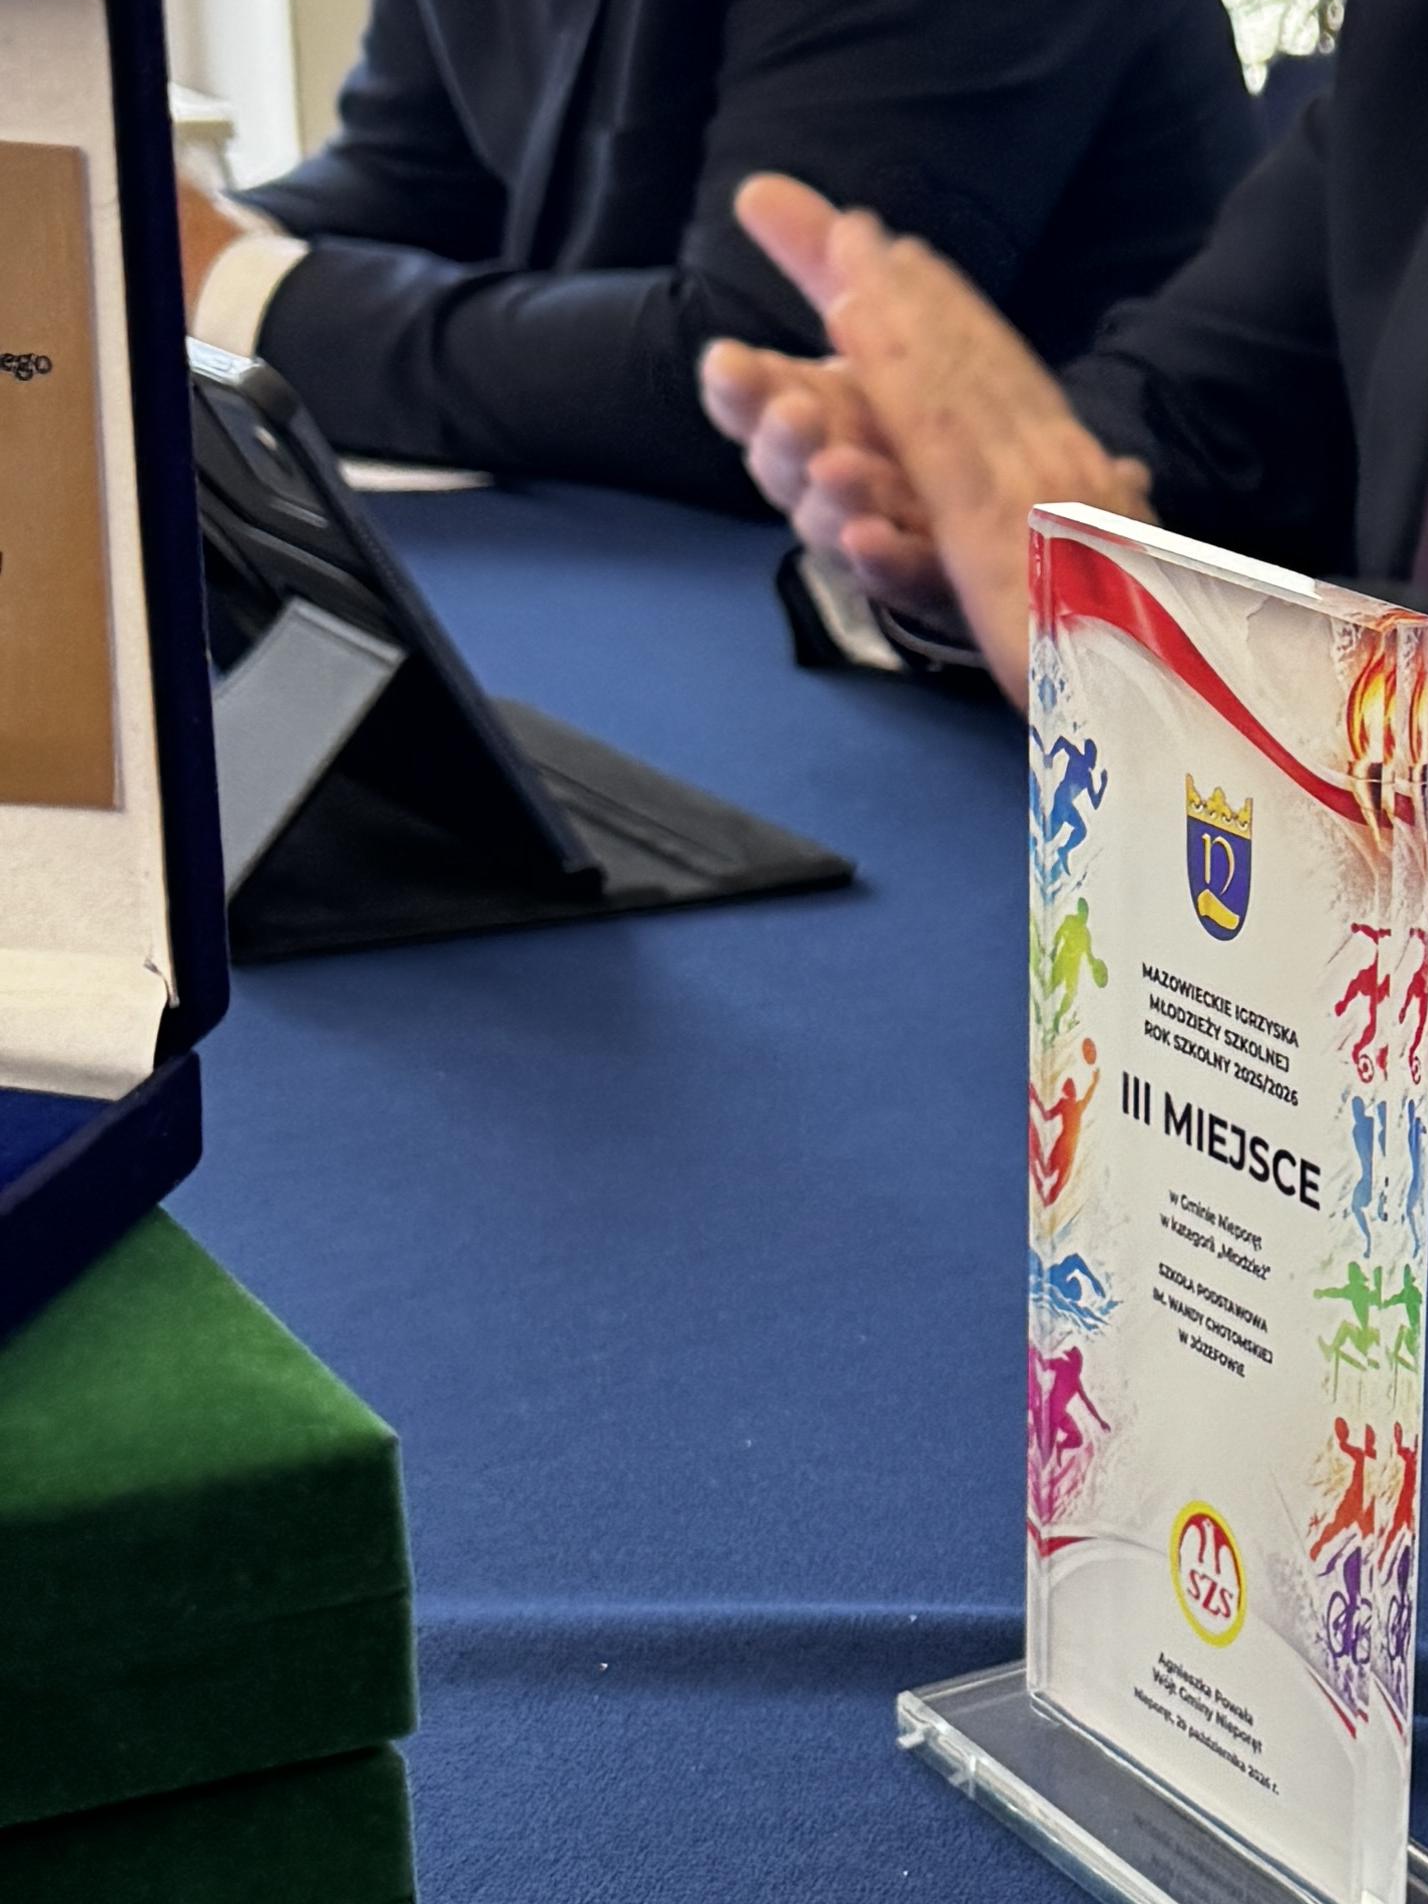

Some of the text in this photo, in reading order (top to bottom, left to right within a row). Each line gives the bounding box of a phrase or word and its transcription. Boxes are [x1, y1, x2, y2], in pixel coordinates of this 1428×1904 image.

[1142, 963, 1300, 1047] MAZOWIECKIE IGRZYSKA
[1144, 1020, 1171, 1046] ROK
[1173, 1035, 1232, 1073] SZKOLNY
[1122, 1072, 1321, 1210] III MIEJSCE
